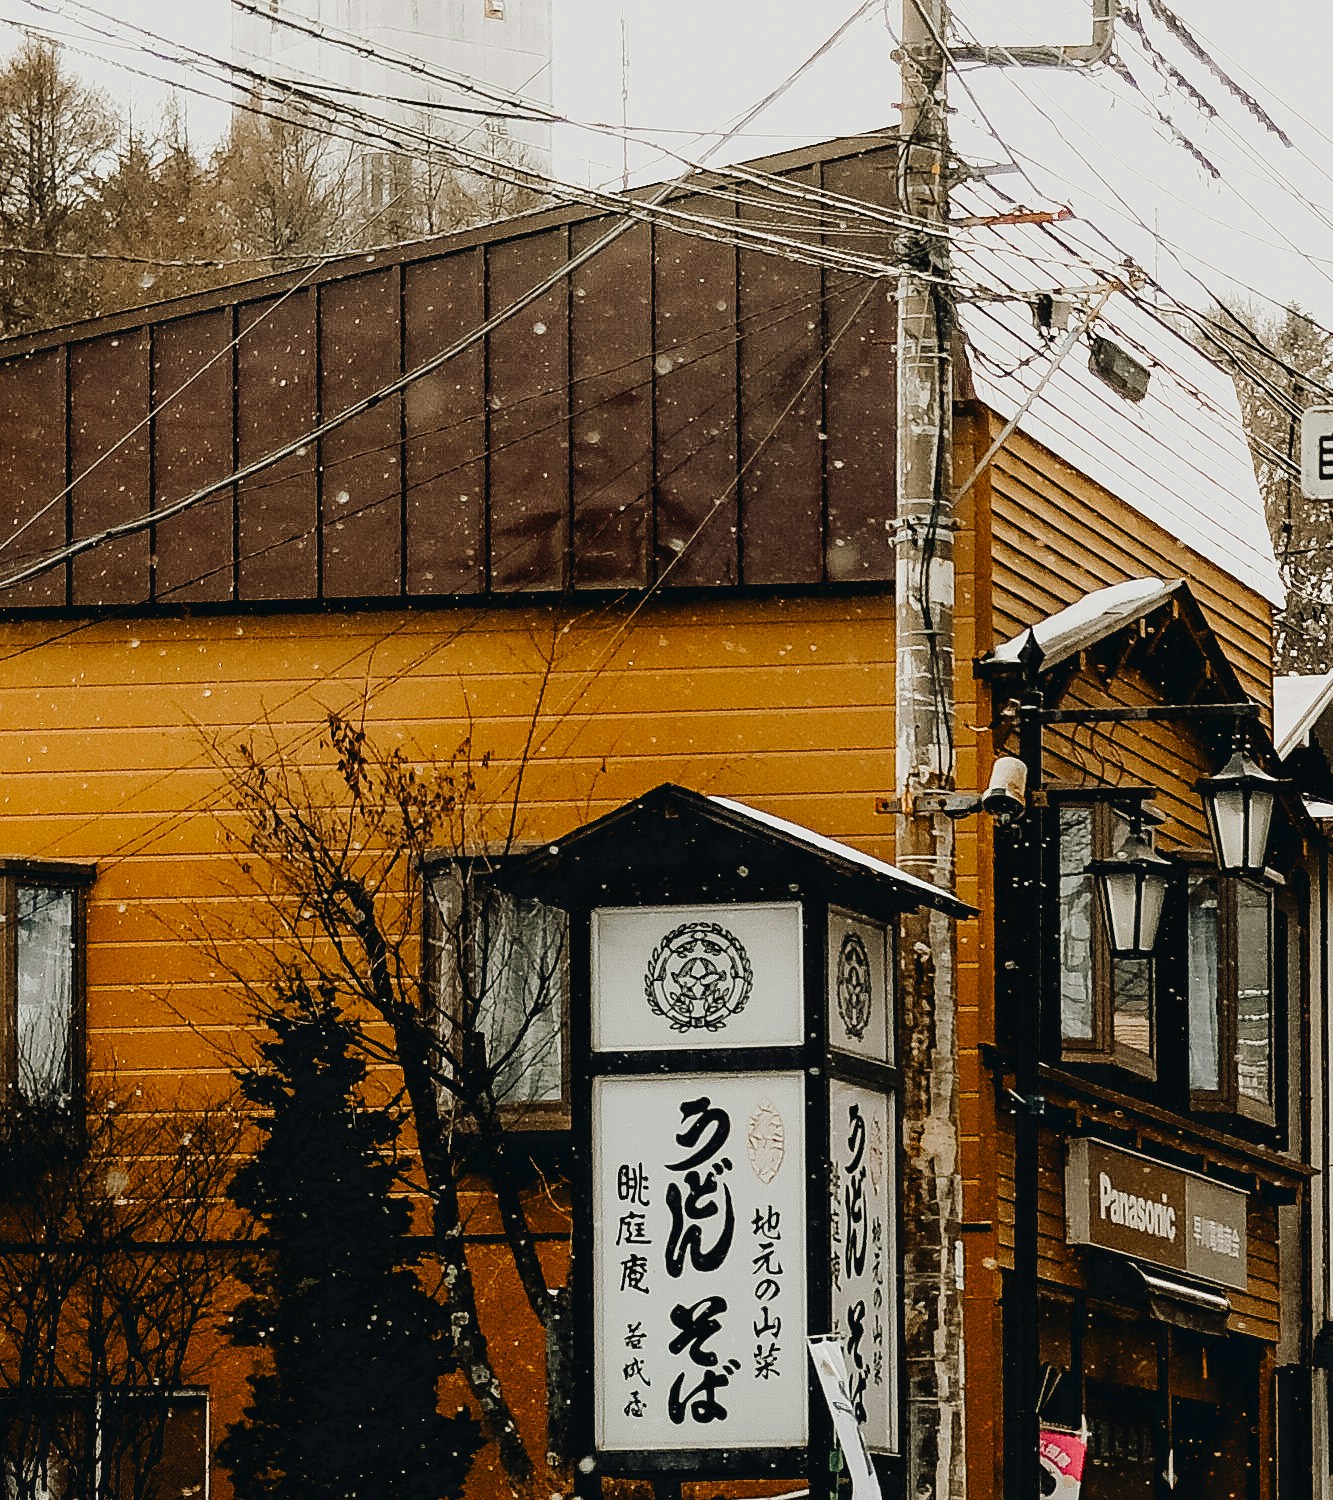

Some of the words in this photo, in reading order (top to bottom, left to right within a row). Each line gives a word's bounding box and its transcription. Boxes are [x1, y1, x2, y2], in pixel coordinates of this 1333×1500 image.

[664, 1096, 735, 1279] うどん
[844, 1103, 868, 1280] うどん
[1100, 1171, 1176, 1243] Panasonic
[667, 1296, 742, 1425] そば
[751, 1204, 784, 1380] 地元の山菜
